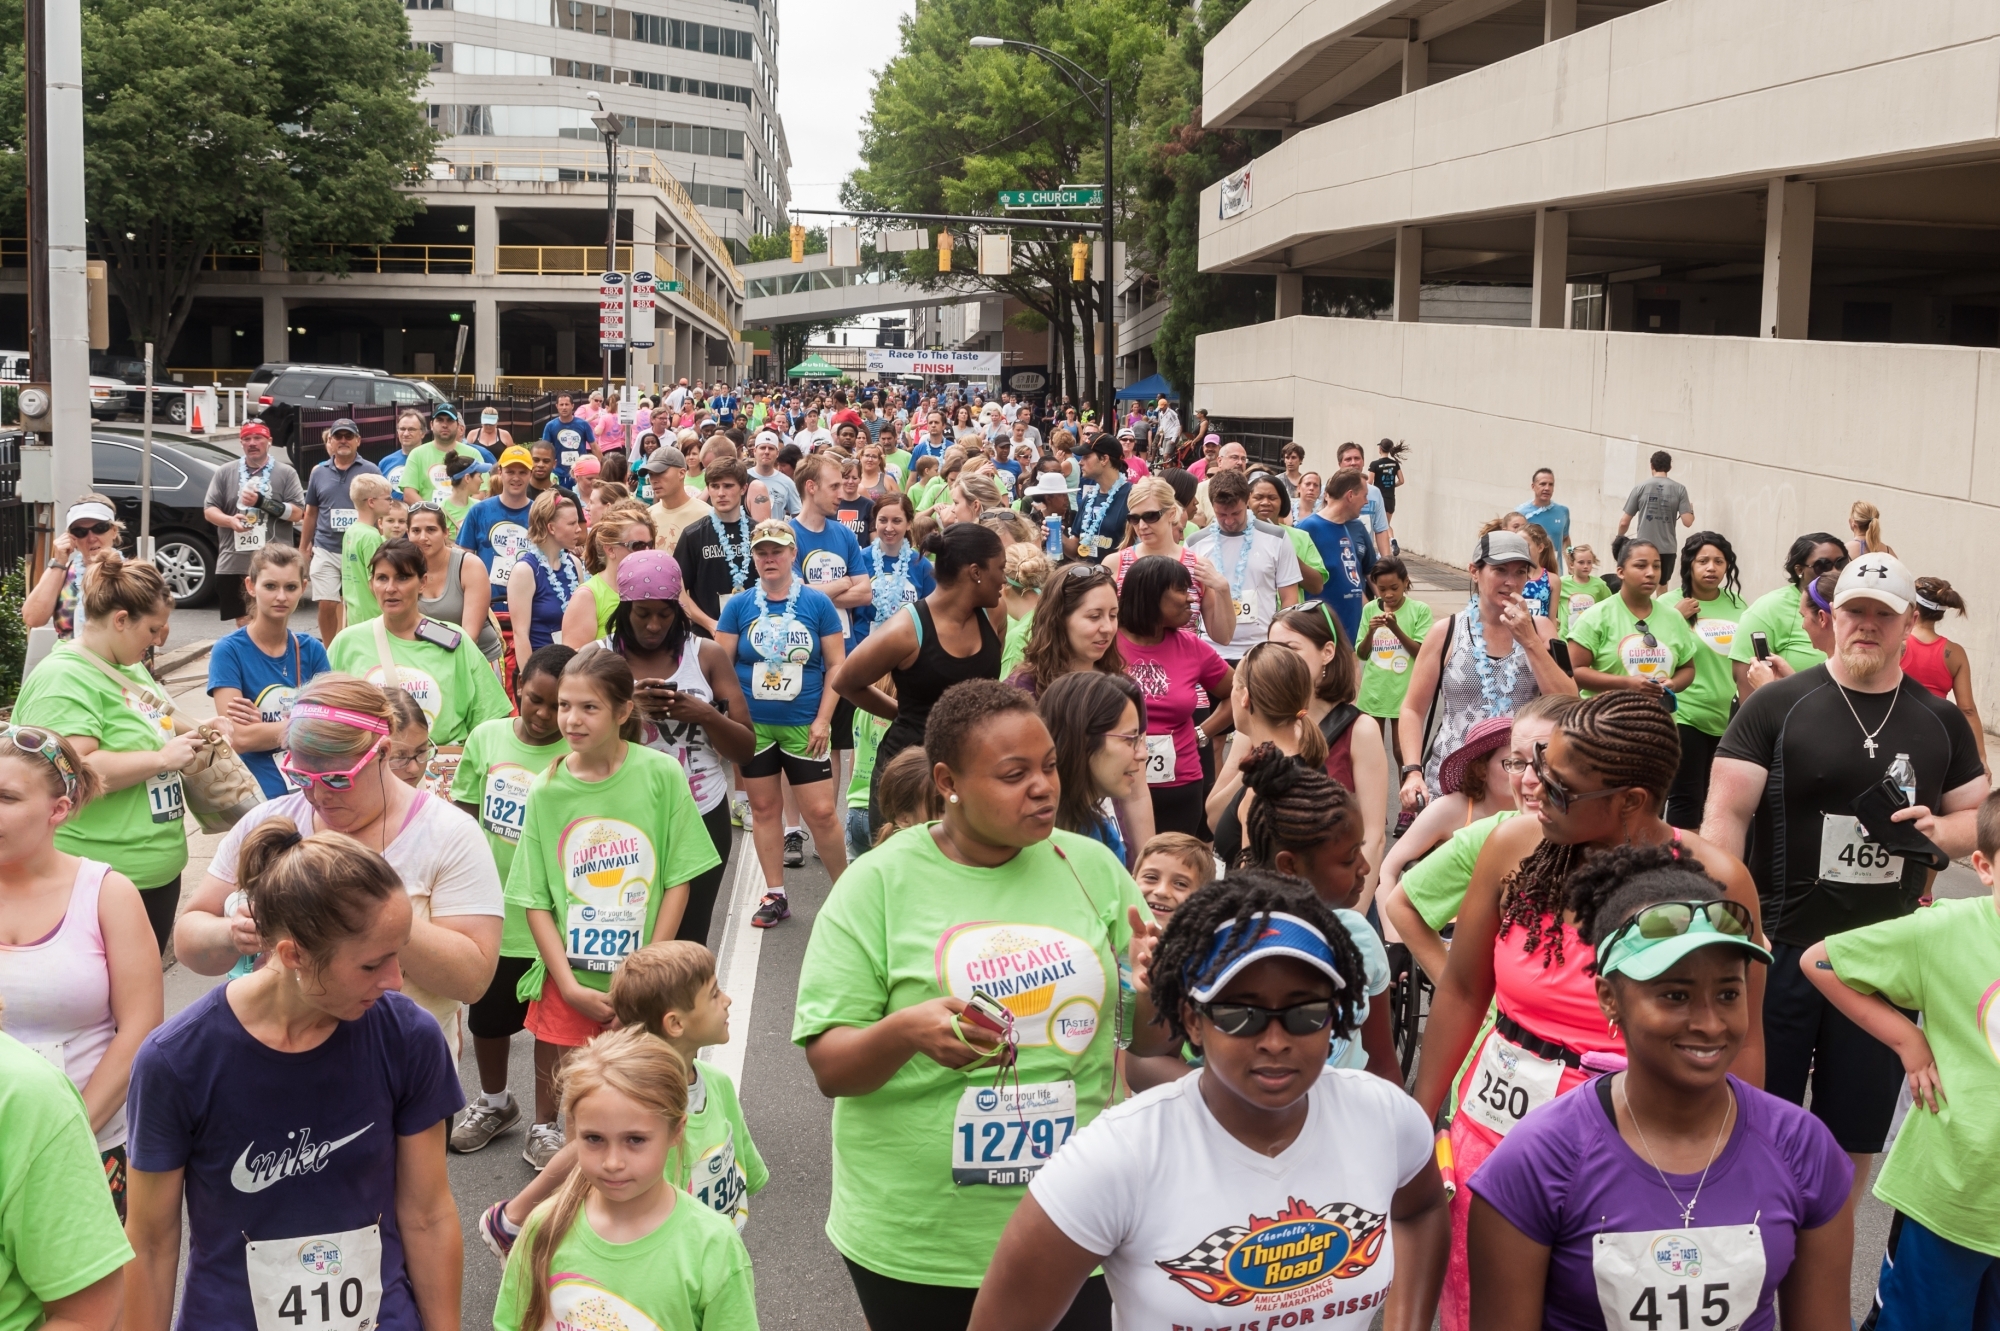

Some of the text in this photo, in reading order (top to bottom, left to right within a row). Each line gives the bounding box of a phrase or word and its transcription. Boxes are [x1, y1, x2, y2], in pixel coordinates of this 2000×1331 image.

[1018, 192, 1076, 202] S CHURCH
[604, 316, 618, 324] 80X
[888, 350, 978, 360] Race To The Taste
[913, 363, 954, 373] FINISH
[1026, 375, 1039, 383] RUN
[240, 536, 259, 545] 240
[494, 534, 508, 546] RACE
[517, 537, 530, 548] TAST
[506, 546, 516, 556] 5K
[810, 568, 822, 579] RACE
[787, 632, 808, 644] TASTE
[1629, 649, 1666, 657] CUPCAKE
[514, 786, 525, 794] your
[486, 795, 525, 826] 1321
[491, 823, 520, 838] Fun Run
[574, 838, 639, 865] CUPCAKE
[1838, 844, 1889, 868] 465
[573, 853, 640, 878] RUN/WALK
[569, 928, 639, 956] 12821
[587, 960, 605, 971] Fun
[966, 941, 1071, 982] CUPCAKE
[1057, 1018, 1088, 1035] TASTE
[1067, 1027, 1093, 1038] Charlotte
[978, 1090, 1051, 1103] run for your life
[1478, 1069, 1528, 1120] 250
[1486, 1112, 1503, 1124] Publix
[959, 1116, 1074, 1162] 12797
[250, 1128, 332, 1183] nike
[988, 1170, 1015, 1183] Fun
[1258, 1223, 1315, 1243] Charlotte's
[1240, 1231, 1338, 1268] Thunder
[1657, 1251, 1671, 1261] RACE
[1680, 1249, 1697, 1260] TASTE
[303, 1253, 315, 1263] RACE
[323, 1250, 338, 1260] TASTE
[316, 1262, 324, 1270] 5K
[1264, 1252, 1324, 1286] Road
[1672, 1262, 1682, 1271] 5K
[1254, 1278, 1333, 1304] AMICA INSURANCE
[278, 1278, 363, 1325] 410
[1255, 1287, 1334, 1311] HALF MARATHON
[1629, 1283, 1730, 1330] 415
[1266, 1308, 1314, 1330] FOR
